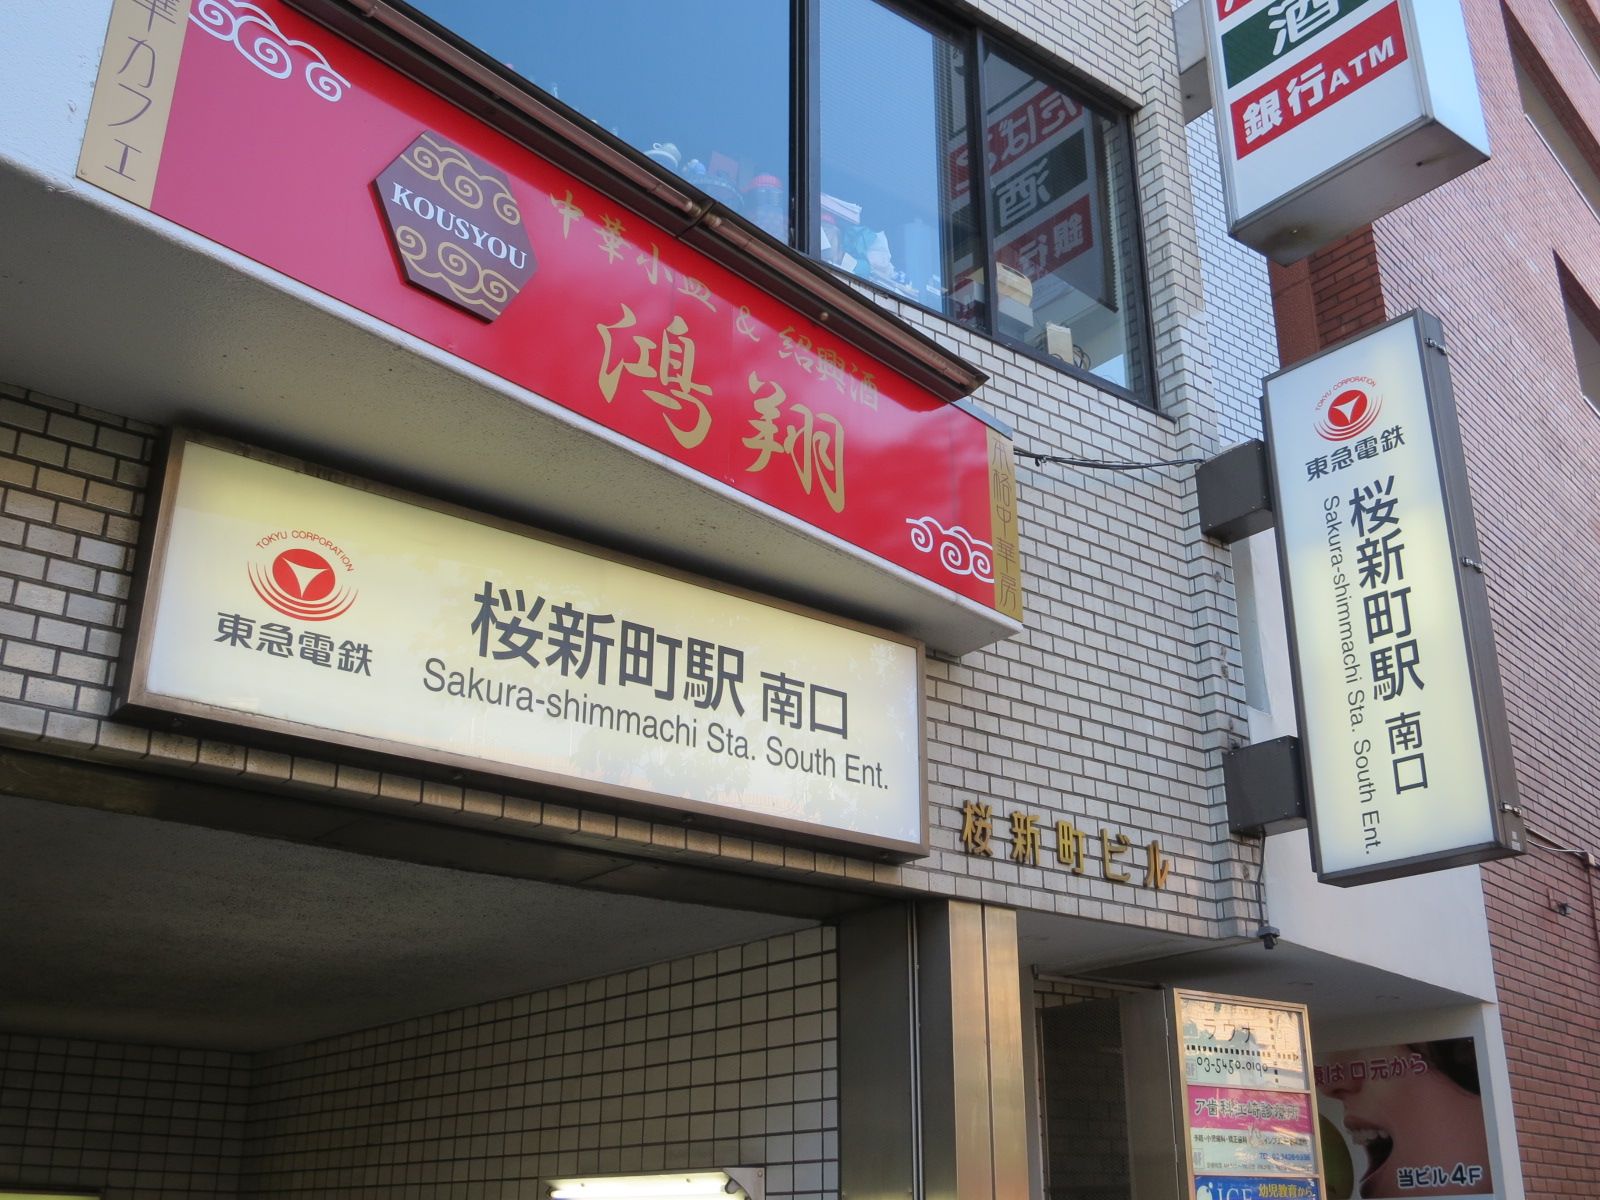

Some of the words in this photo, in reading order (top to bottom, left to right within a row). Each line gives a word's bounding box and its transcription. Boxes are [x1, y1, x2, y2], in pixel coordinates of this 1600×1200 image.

[391, 182, 527, 269] KOUSYOU
[1315, 389, 1332, 411] TOKYU
[1332, 376, 1377, 391] CORPORATION
[1305, 425, 1406, 482] 東急電鉄
[256, 530, 288, 550] TOKYU
[291, 529, 355, 573] CORPORATION
[1324, 495, 1363, 684] Sakura-shimmachi
[1349, 475, 1425, 701] 桜新町駅
[214, 612, 373, 677] 東急電鉄
[471, 581, 745, 717] 桜新町駅
[760, 671, 848, 740] 南口
[423, 657, 697, 748] Sakura-shimmachi
[707, 722, 756, 761] Sta.
[766, 736, 836, 778] South
[846, 753, 889, 790] Ent.
[1348, 689, 1365, 732] Sta.
[1354, 739, 1377, 804] South
[1385, 711, 1428, 795] 南口
[960, 800, 1169, 889] 桜新町ビル
[1362, 810, 1382, 855] Ent.
[1196, 1056, 1268, 1078] 03-5450-0190
[1398, 1163, 1483, 1188] 当ビル4F
